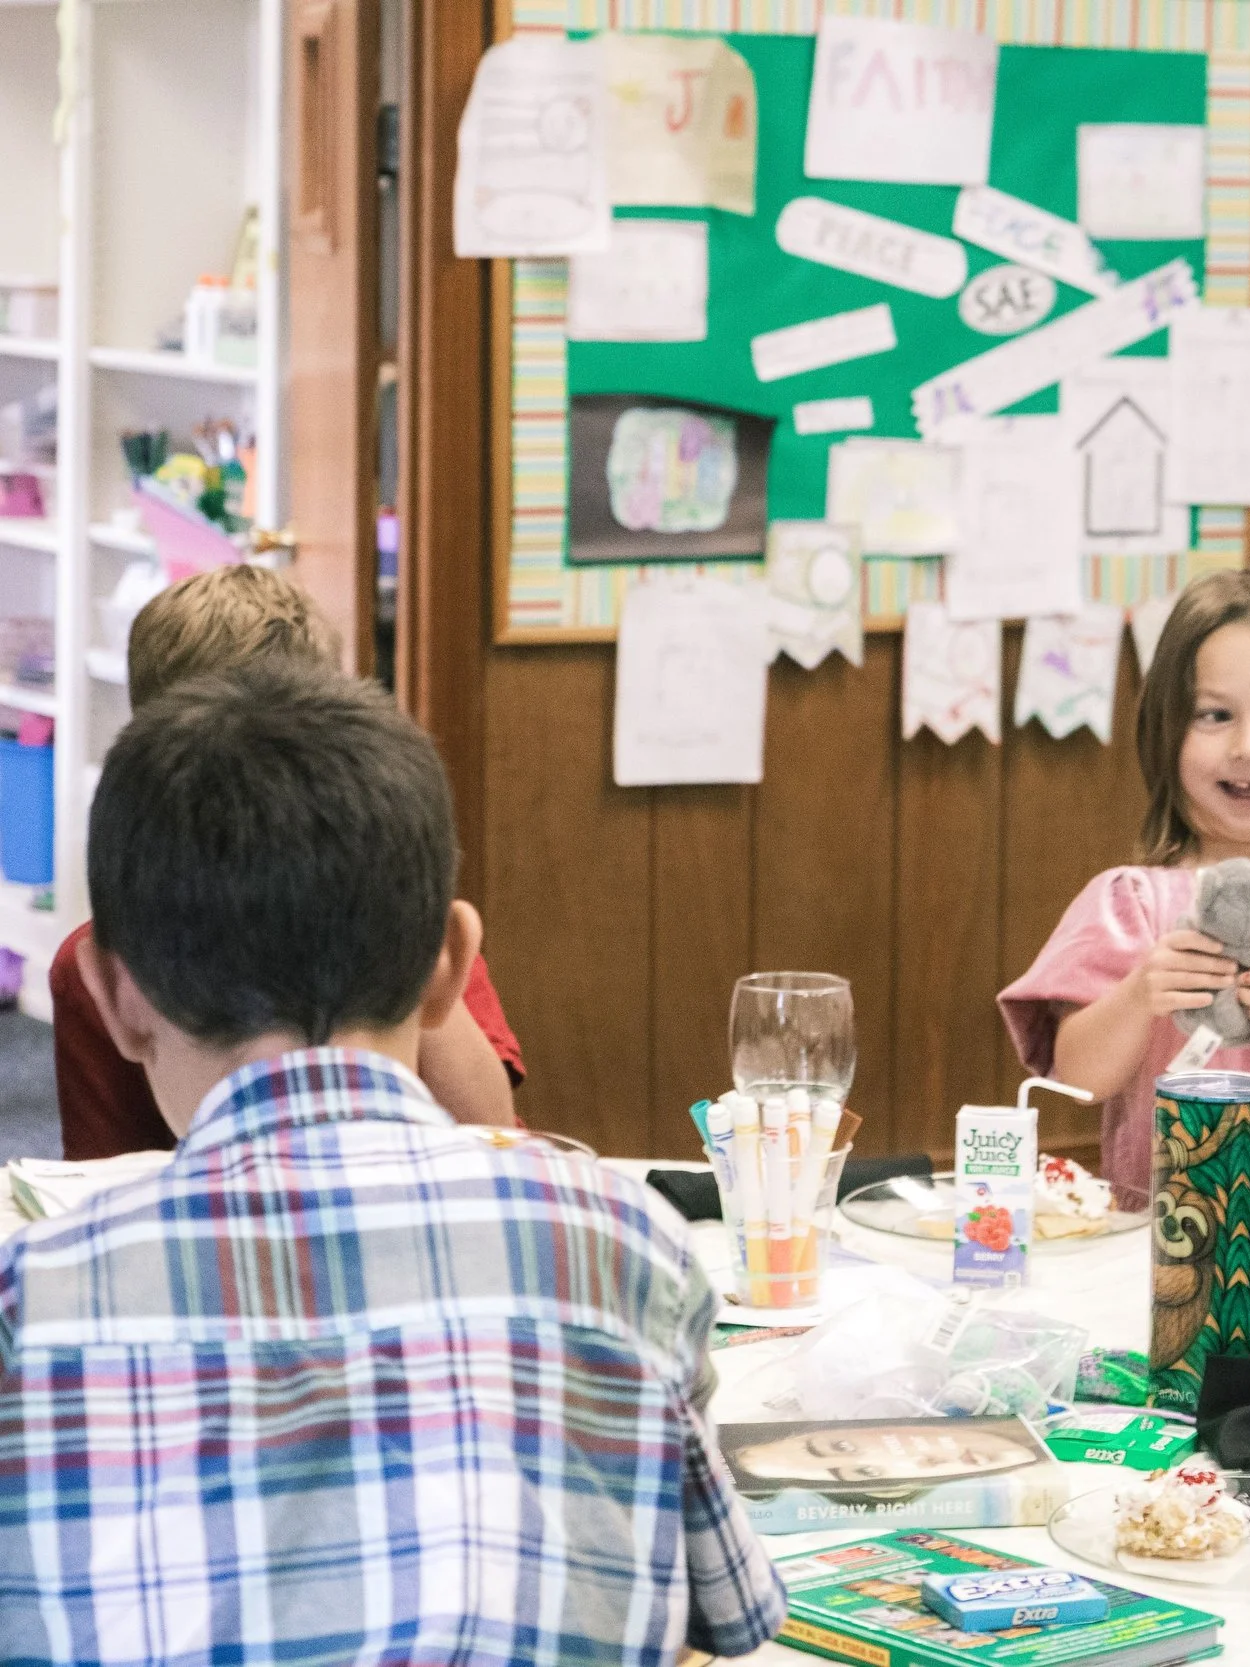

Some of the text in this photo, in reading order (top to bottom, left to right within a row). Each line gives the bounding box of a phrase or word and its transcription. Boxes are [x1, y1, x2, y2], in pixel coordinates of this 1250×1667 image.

[963, 1129, 1022, 1150] Juicy
[967, 1147, 1017, 1162] Juice
[797, 1503, 868, 1521] BEVERLY,
[876, 1502, 926, 1517] RIGHT
[934, 1500, 975, 1515] HERE
[950, 1571, 1075, 1601] Extra
[1011, 1606, 1059, 1626] Extra
